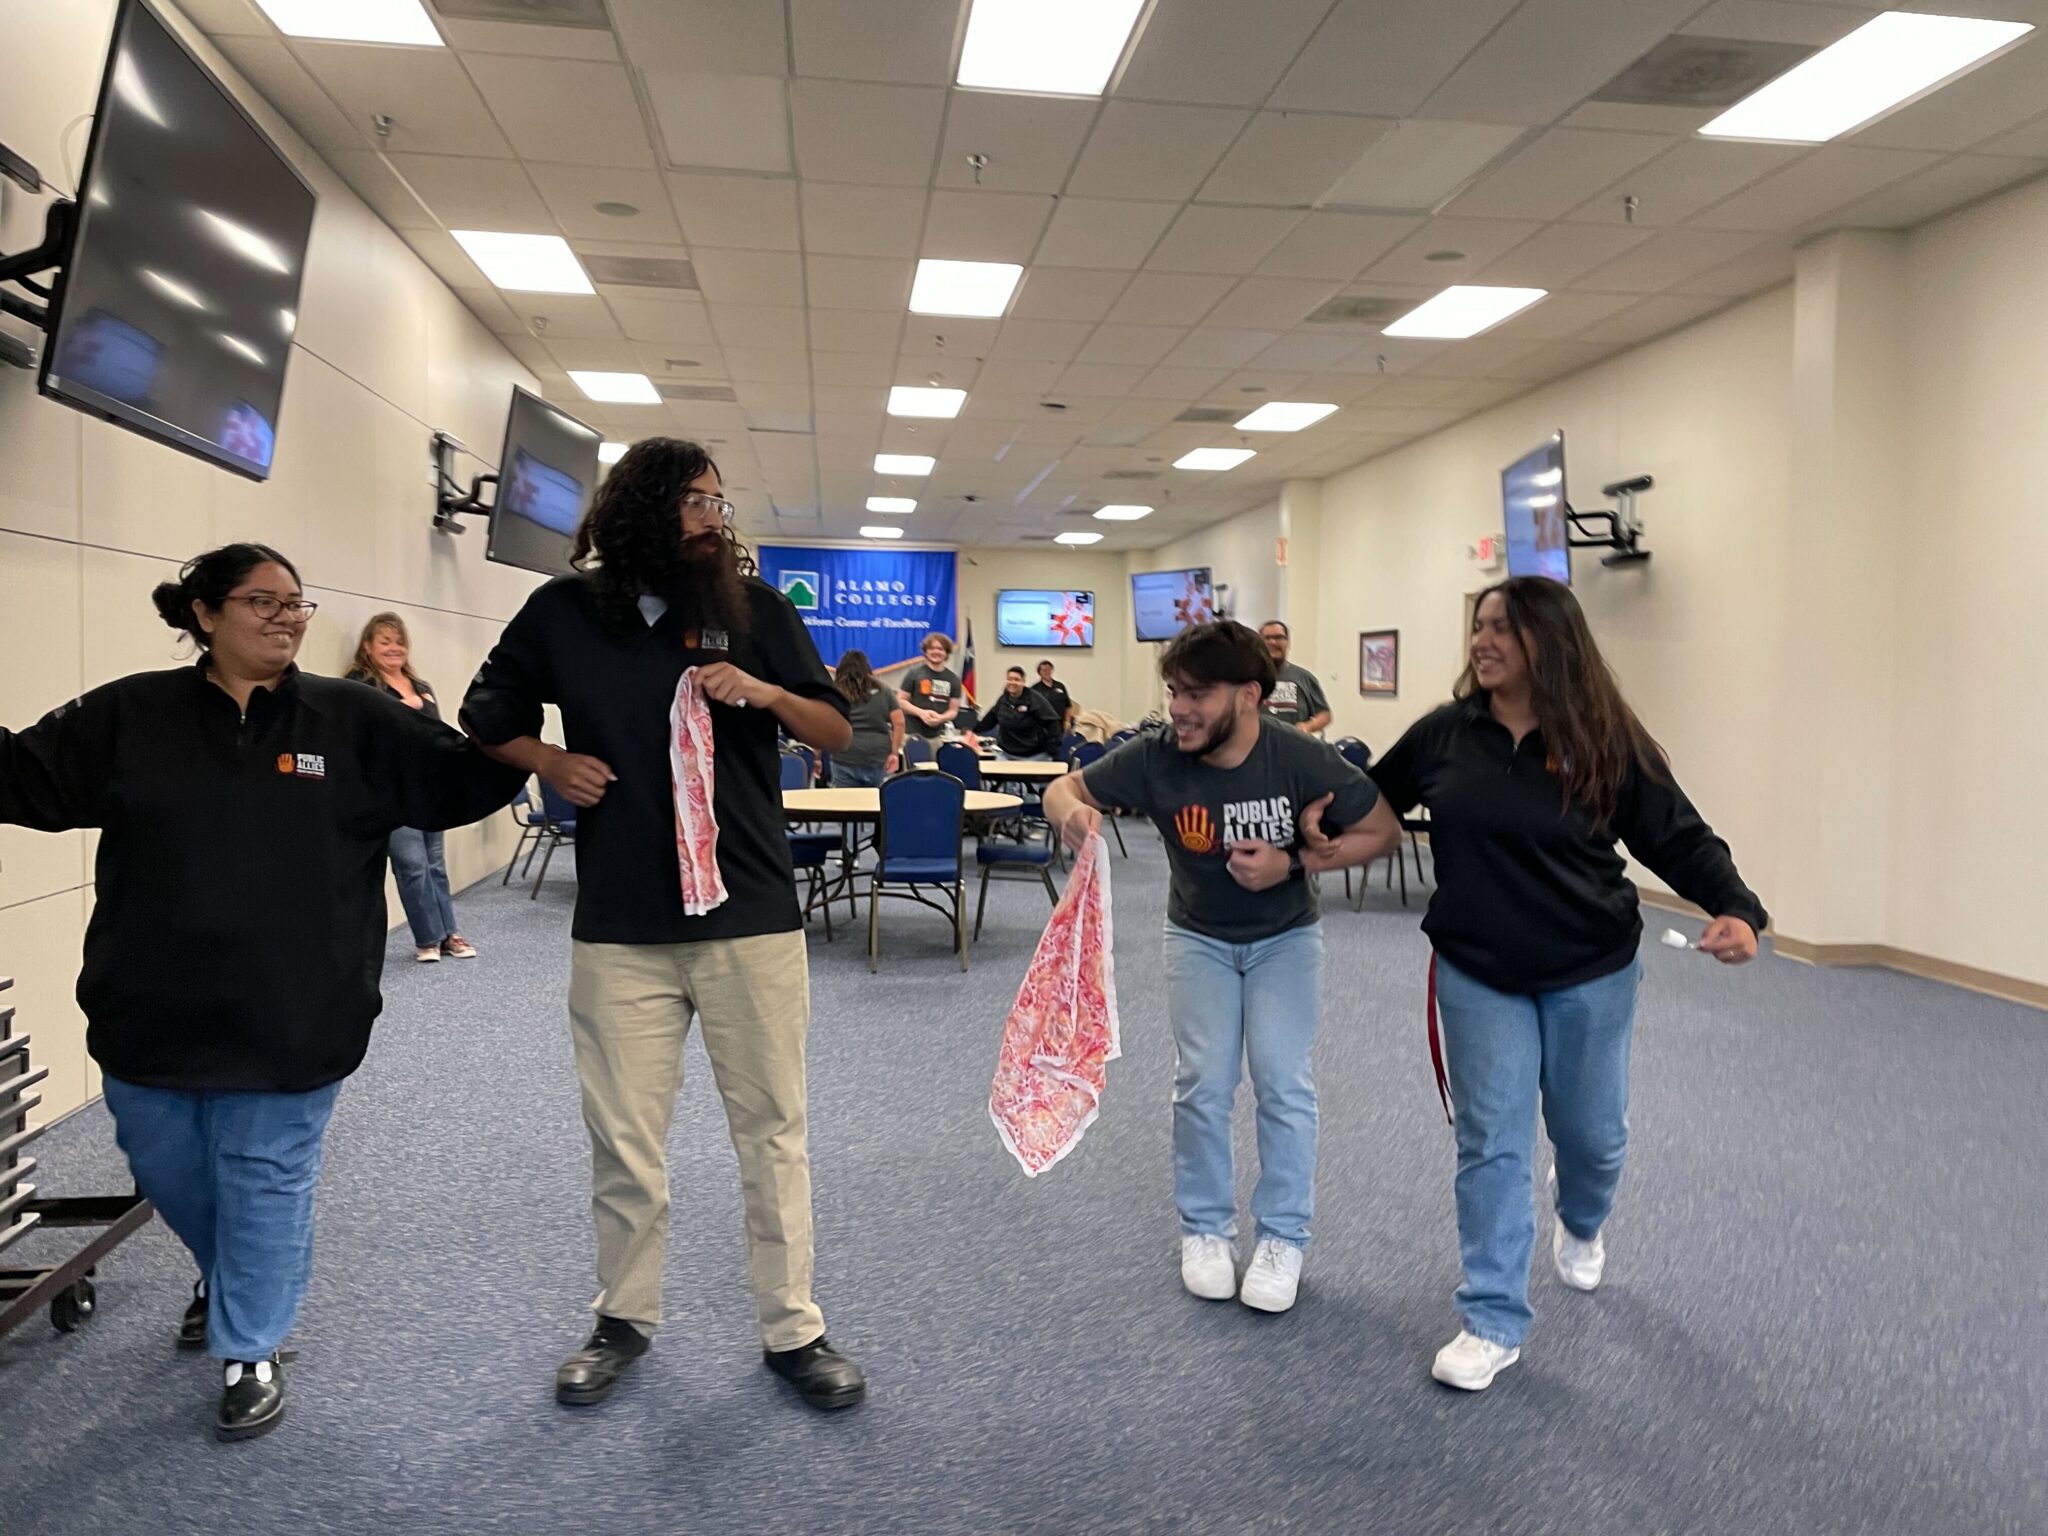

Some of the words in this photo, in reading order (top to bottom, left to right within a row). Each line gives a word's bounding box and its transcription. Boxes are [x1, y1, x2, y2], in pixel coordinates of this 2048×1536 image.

[835, 579, 905, 593] ALAMO
[834, 592, 937, 606] COLLEGES
[1223, 795, 1292, 825] PUBLIC
[1223, 819, 1295, 844] ALLIES
